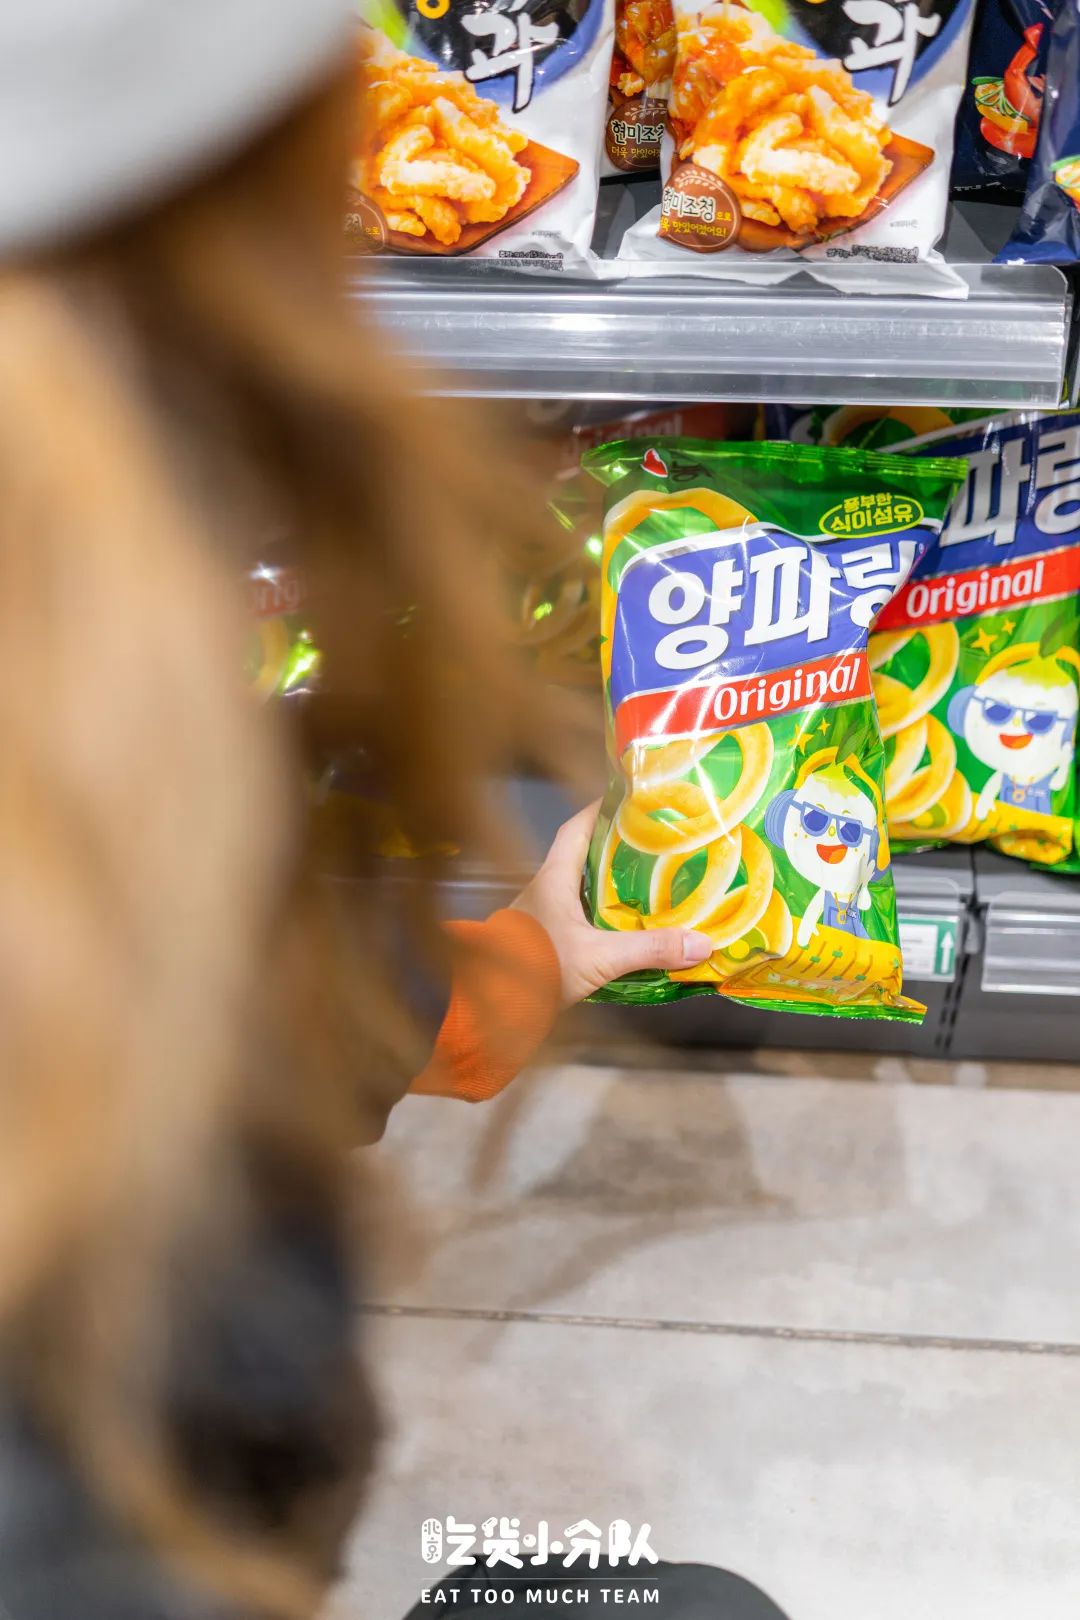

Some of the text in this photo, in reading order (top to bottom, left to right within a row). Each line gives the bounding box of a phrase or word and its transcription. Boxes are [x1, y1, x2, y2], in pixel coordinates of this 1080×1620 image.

[461, 12, 559, 113] 과
[842, 0, 941, 107] 과
[631, 148, 660, 159] 맛있어
[830, 503, 913, 532] 식이섬유
[844, 492, 892, 513] 풍부한
[939, 425, 1080, 547] 파링
[648, 540, 918, 670] 양파링
[906, 560, 1045, 618] Original
[713, 657, 861, 721] Original
